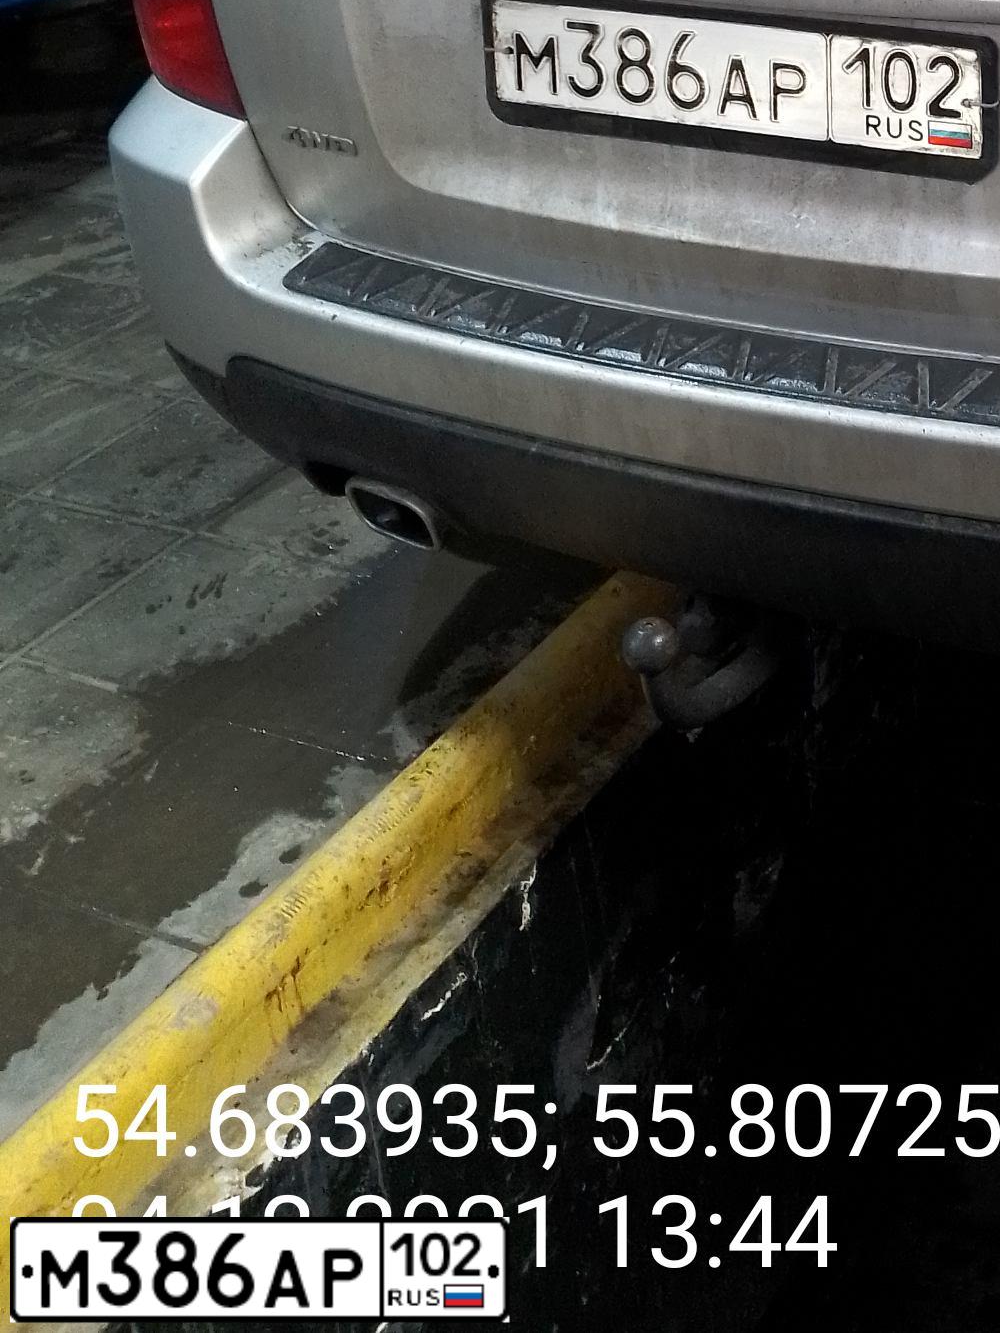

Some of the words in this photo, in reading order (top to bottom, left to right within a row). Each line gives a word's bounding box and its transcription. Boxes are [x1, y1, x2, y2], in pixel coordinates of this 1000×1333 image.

[513, 20, 805, 122] М386АР
[843, 45, 963, 120] 102
[866, 114, 924, 142] RUS
